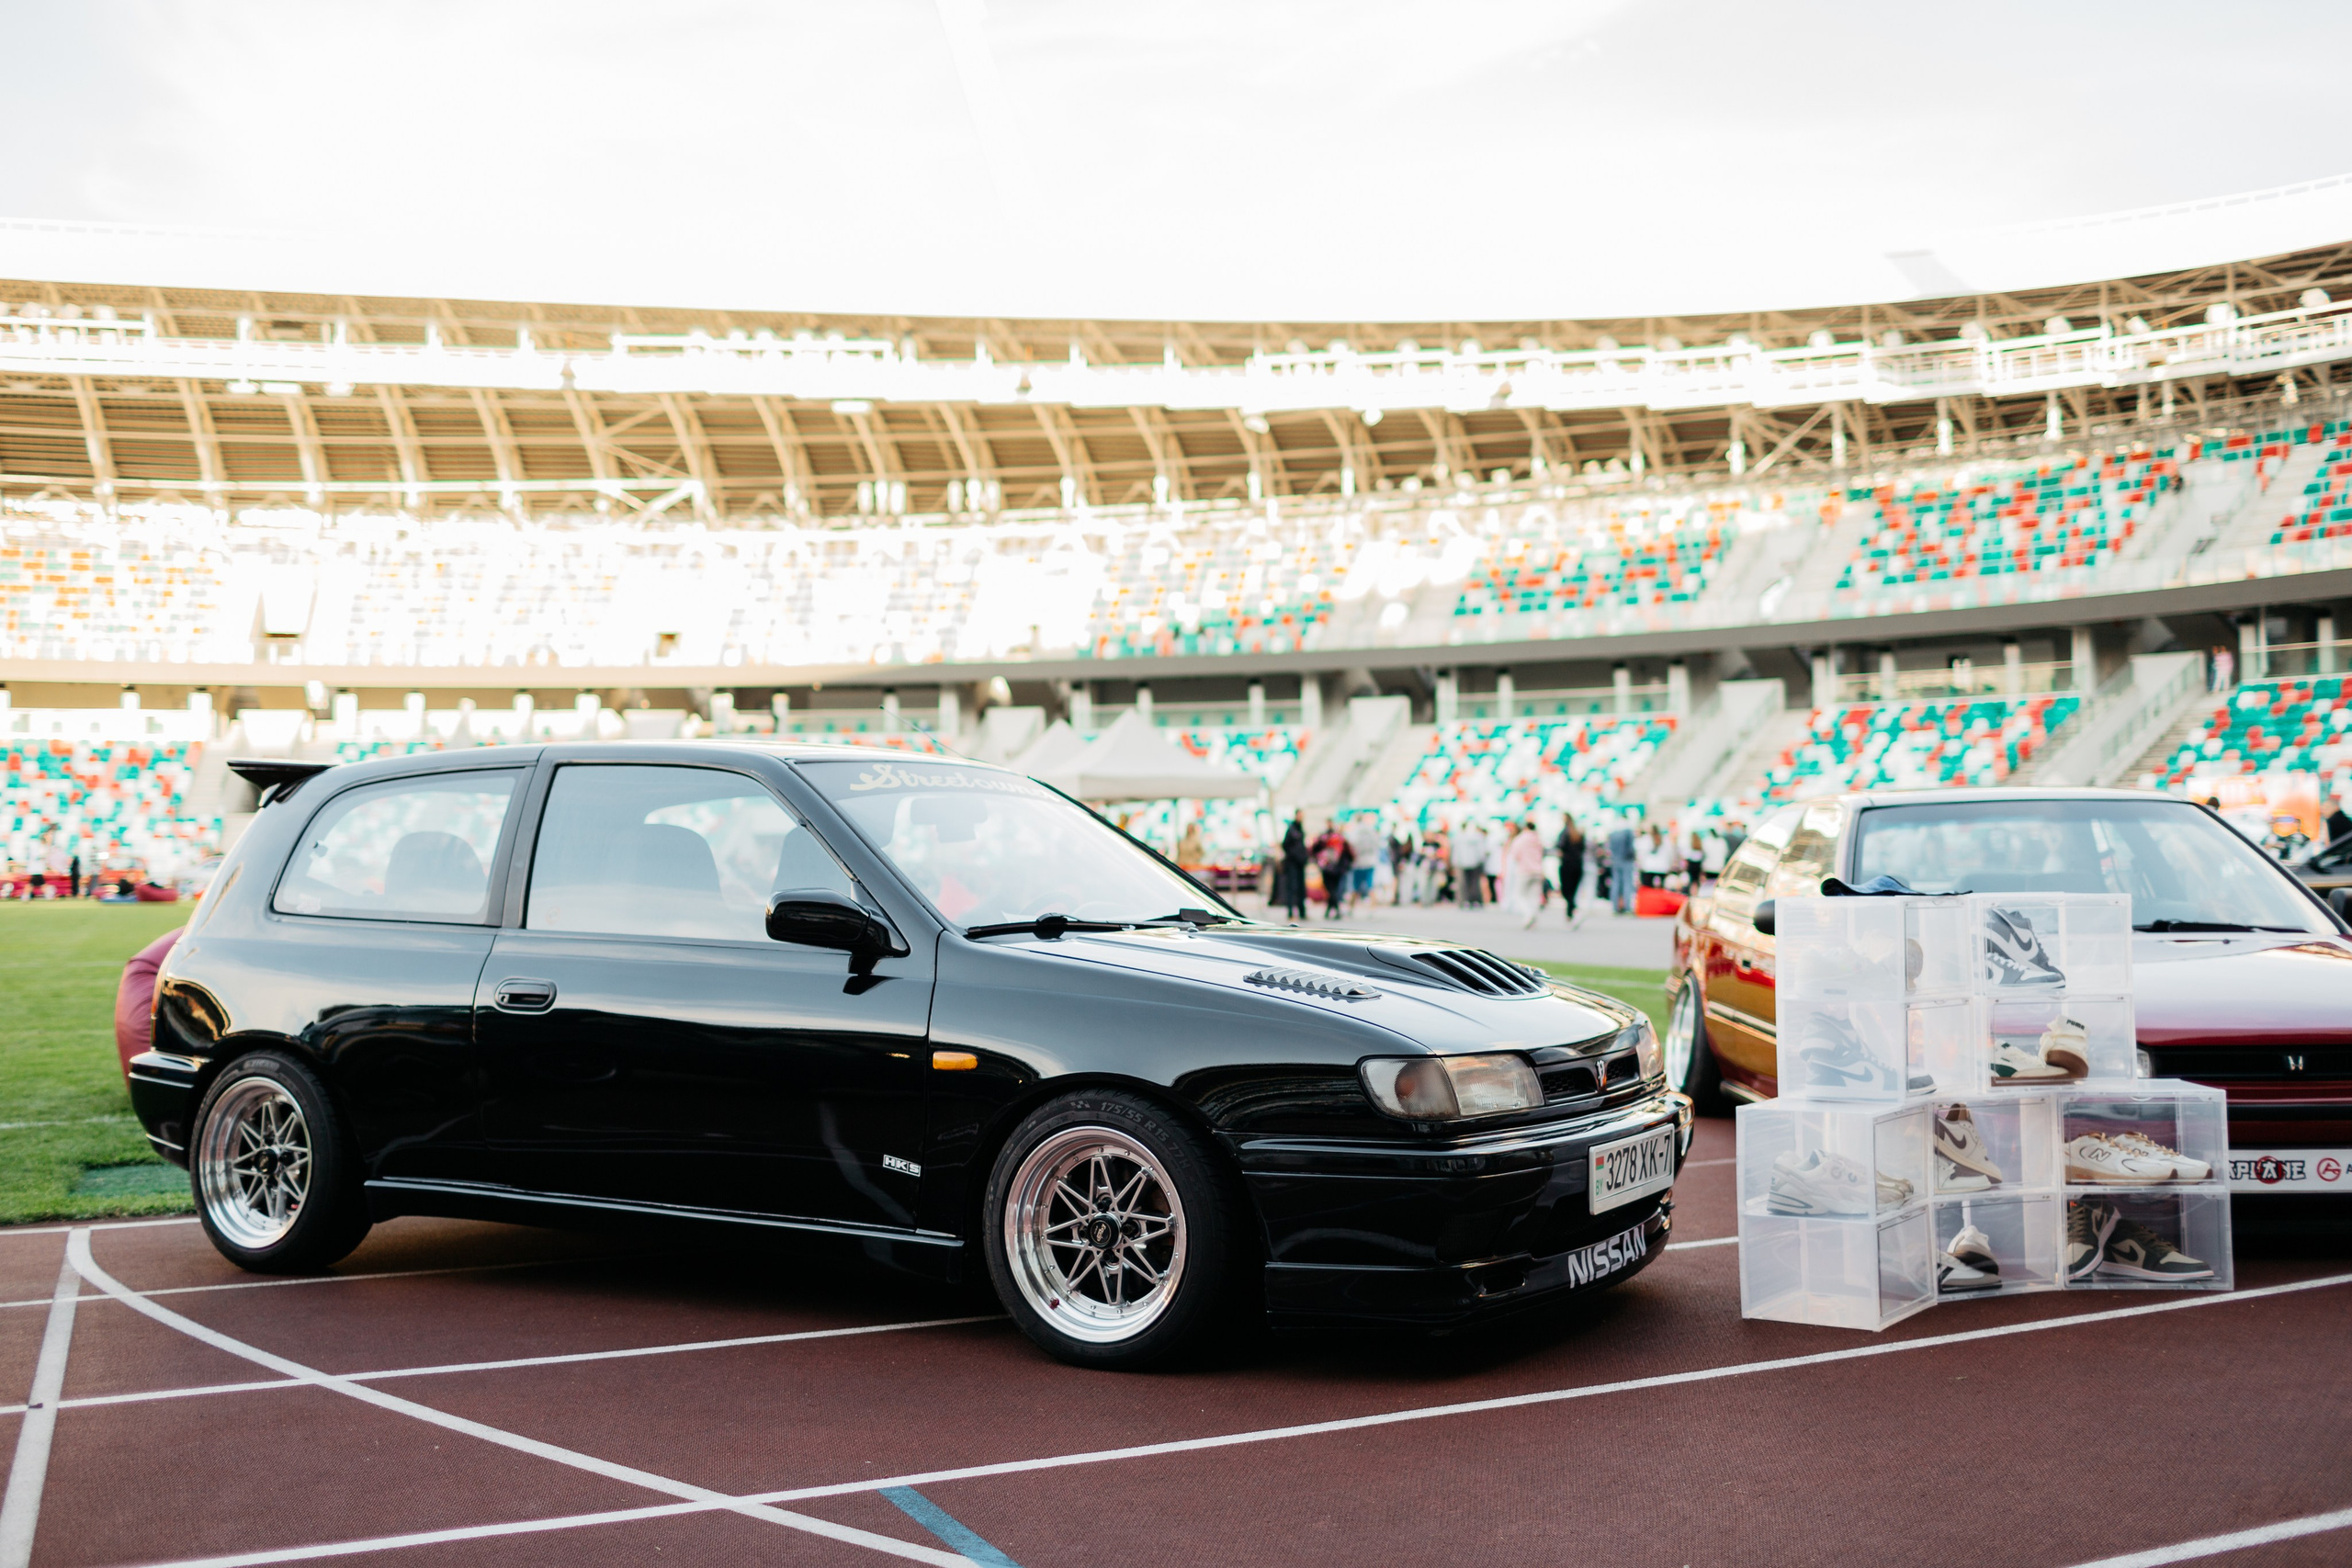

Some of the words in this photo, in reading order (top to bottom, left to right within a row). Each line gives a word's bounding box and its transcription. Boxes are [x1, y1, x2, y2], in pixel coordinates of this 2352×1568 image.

[1101, 1102, 1144, 1122] 175/55
[1154, 1128, 1170, 1142] 15
[885, 1156, 920, 1174] HKS
[1606, 1145, 1637, 1191] 3278
[1595, 1177, 1604, 1196] BY
[1567, 1224, 1647, 1290] NISSAN
